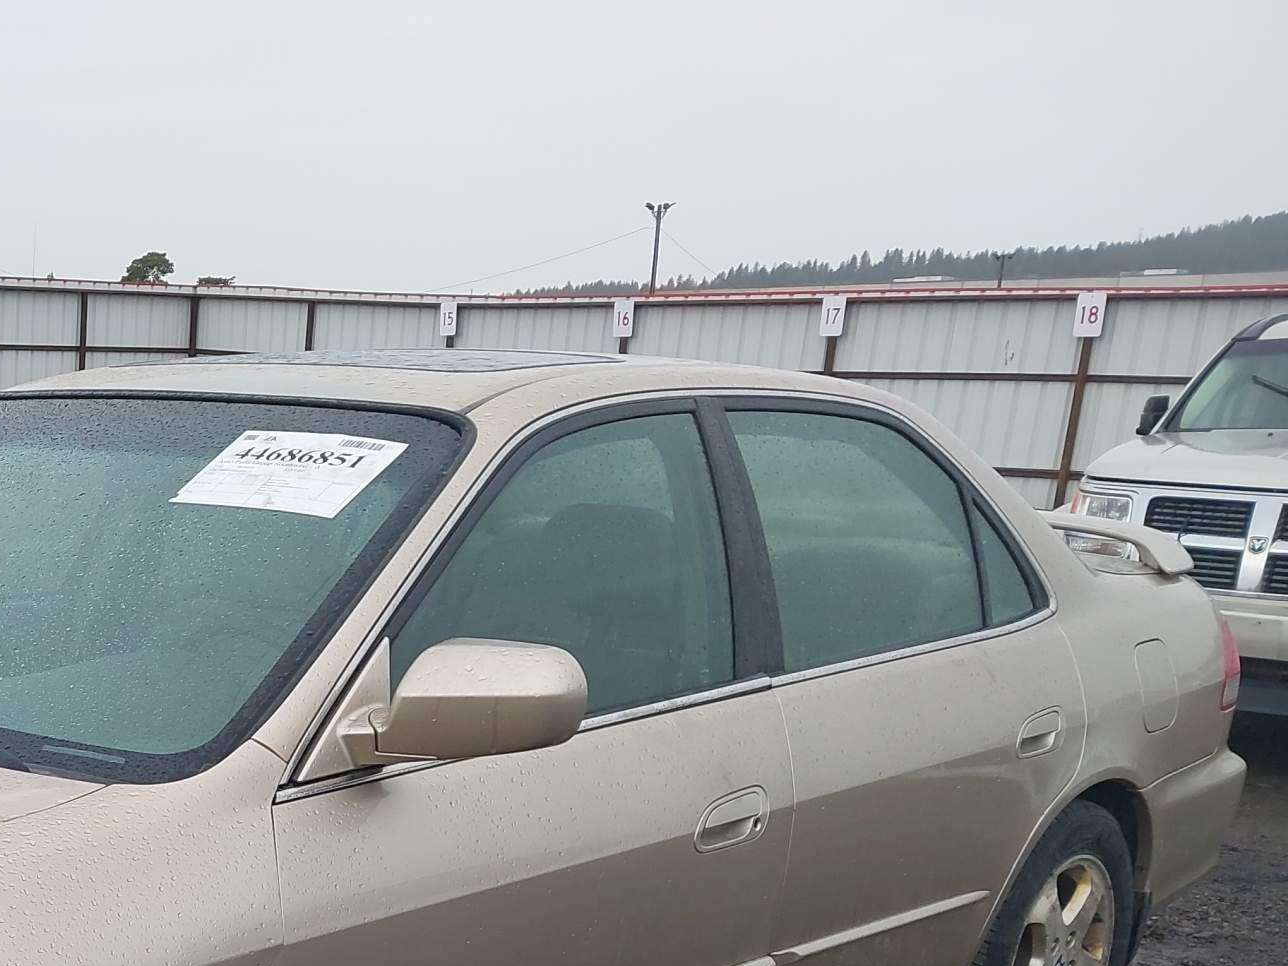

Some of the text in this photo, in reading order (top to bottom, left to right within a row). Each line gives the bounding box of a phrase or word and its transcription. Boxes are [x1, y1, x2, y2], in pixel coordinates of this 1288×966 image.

[443, 311, 454, 326] 15
[617, 311, 630, 327] 16
[825, 307, 841, 325] 17
[1080, 305, 1099, 324] 18
[235, 446, 367, 469] 44686851
